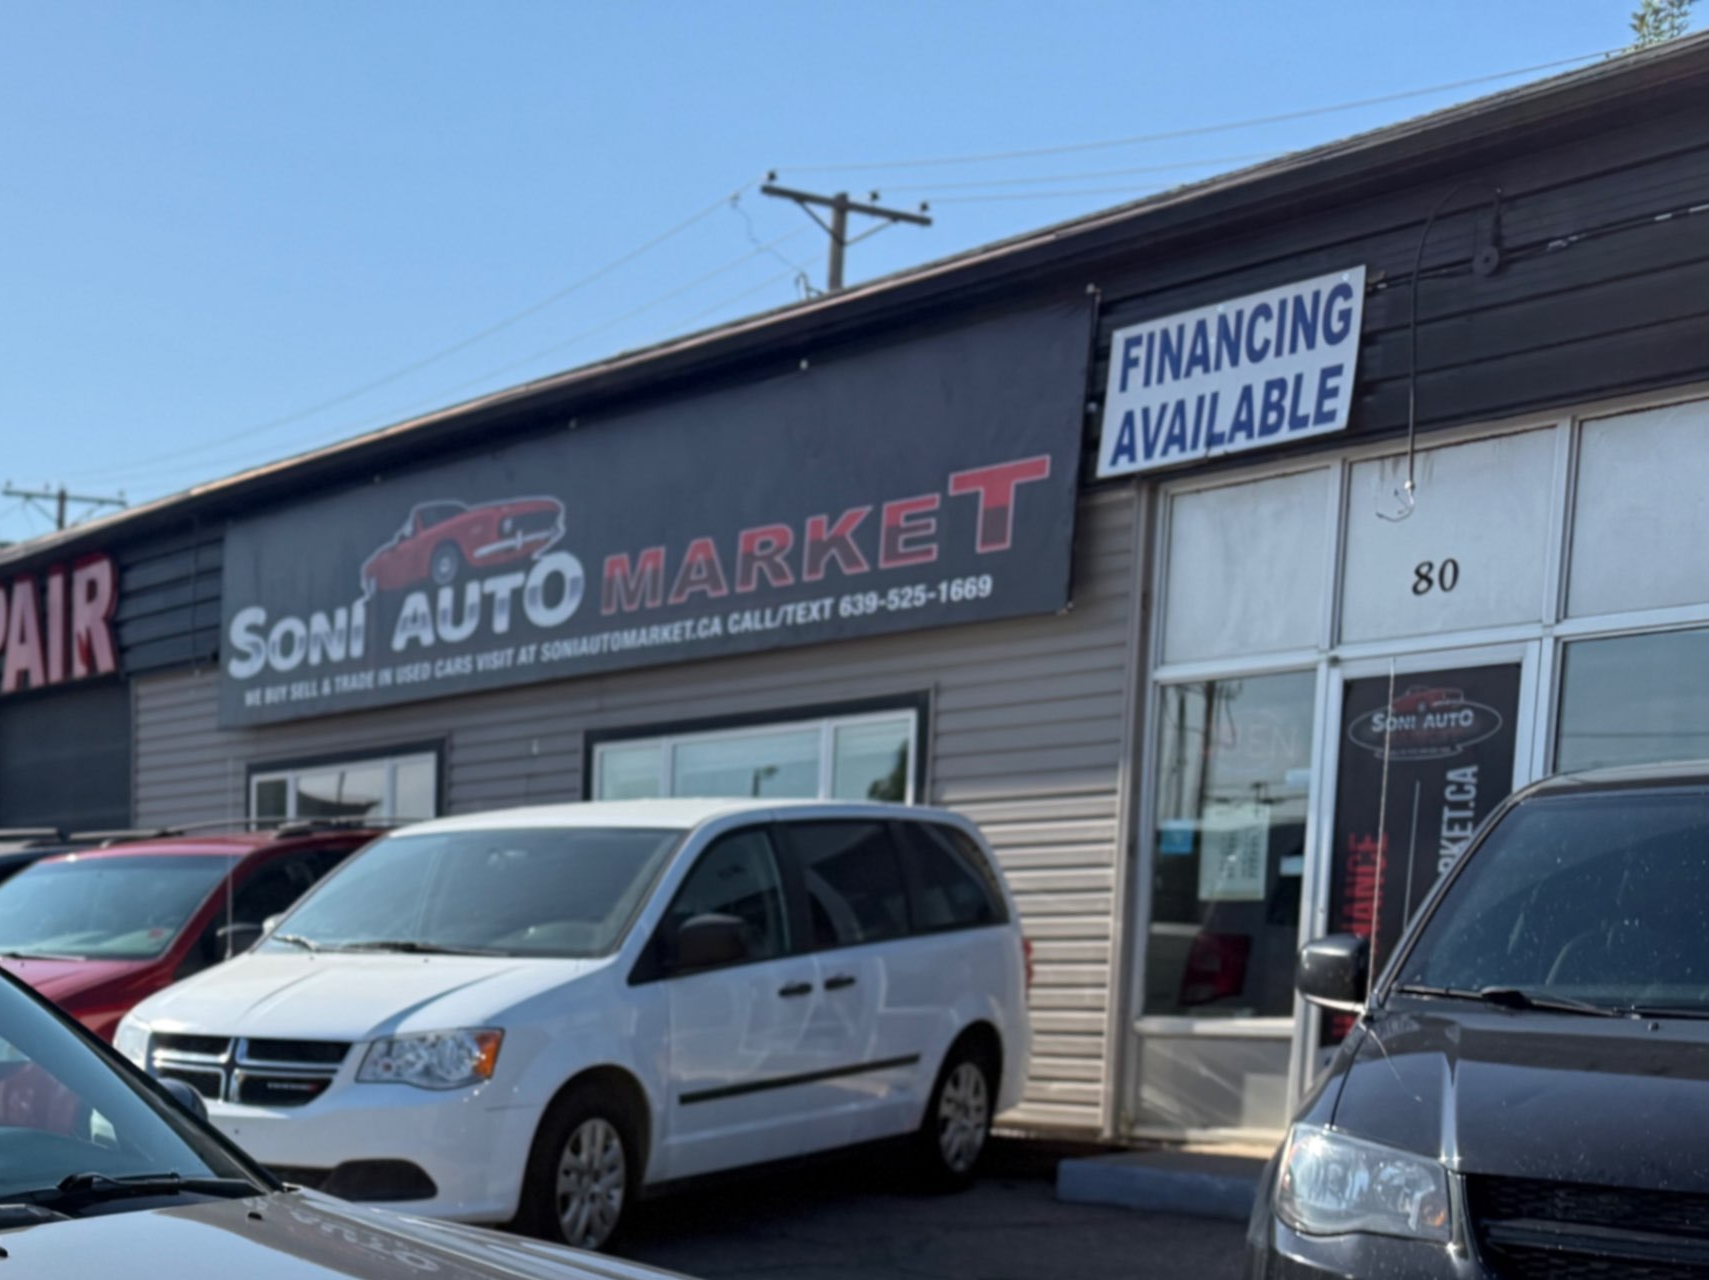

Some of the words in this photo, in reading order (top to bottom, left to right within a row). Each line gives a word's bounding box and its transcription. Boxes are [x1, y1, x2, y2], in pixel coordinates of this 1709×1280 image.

[1119, 281, 1355, 393] FINANCING
[1110, 363, 1345, 468] AVAILABLE
[391, 550, 585, 651] AUTO
[600, 454, 1051, 615] MARKET
[1411, 558, 1460, 596] 80
[245, 687, 262, 707] WE
[265, 683, 288, 704] BUY
[289, 680, 319, 701] SELL
[321, 677, 332, 696] &
[334, 669, 374, 692] TRADE
[377, 667, 393, 687] IN
[395, 661, 431, 685] USED
[434, 655, 473, 678] CARS
[476, 649, 513, 672] VISIT
[516, 644, 537, 666] AT
[540, 615, 723, 662] SONIAUTOMARKET.CA
[727, 597, 834, 634] CALL/TEXT
[838, 574, 993, 618] 639-525-1669
[1422, 709, 1475, 730] AUTO
